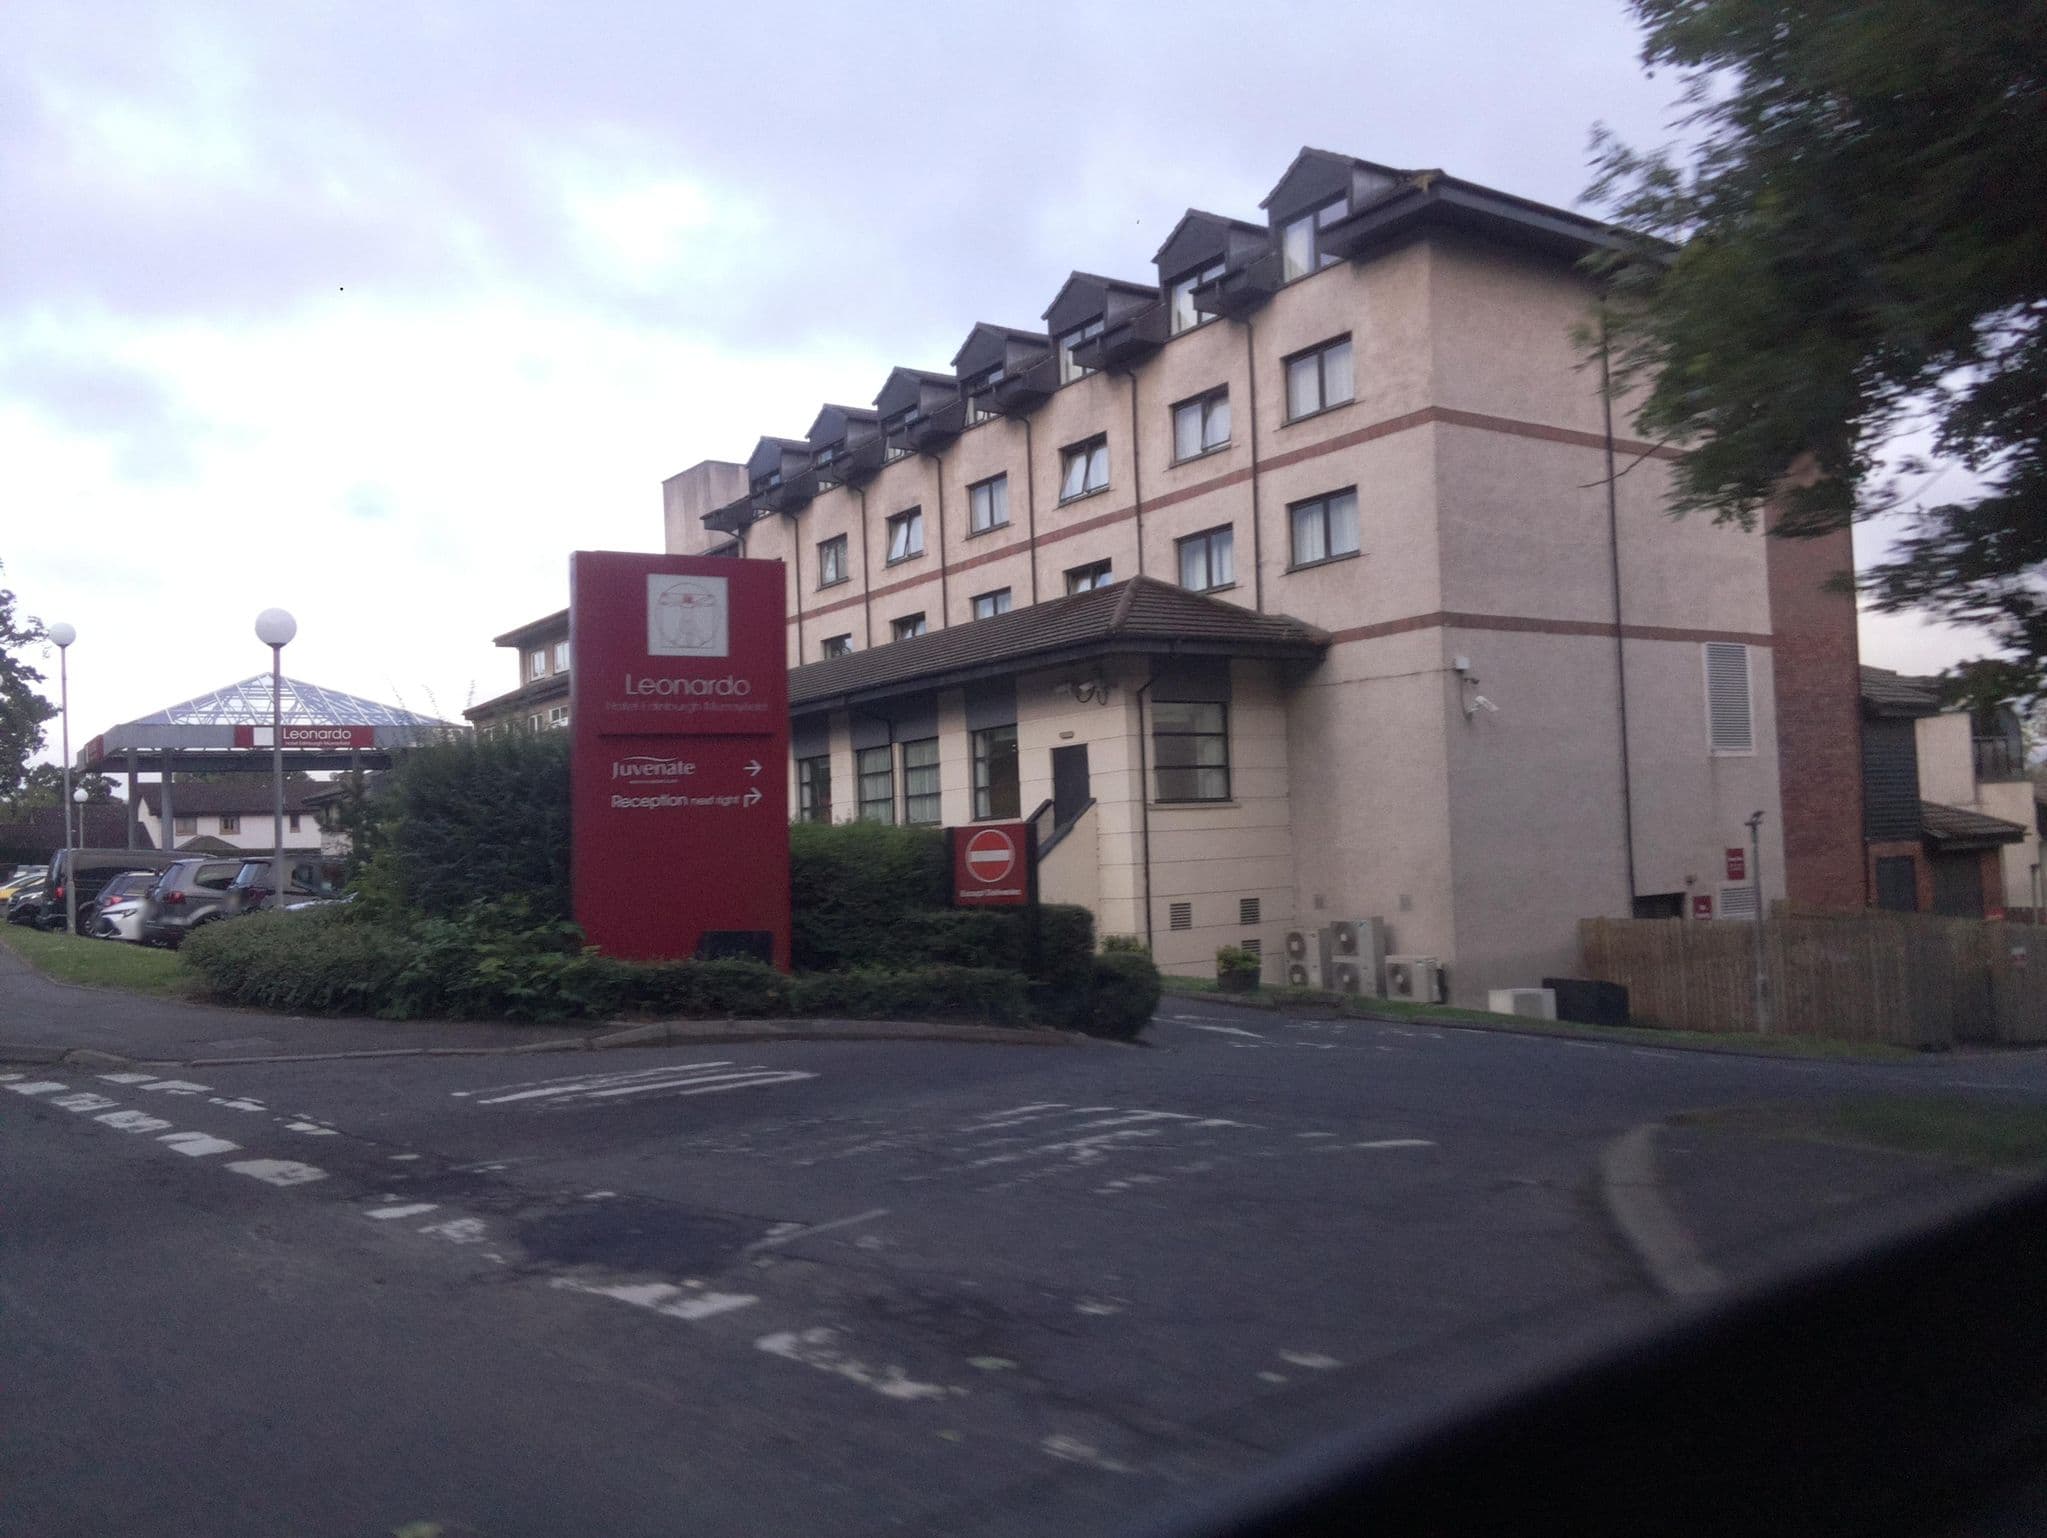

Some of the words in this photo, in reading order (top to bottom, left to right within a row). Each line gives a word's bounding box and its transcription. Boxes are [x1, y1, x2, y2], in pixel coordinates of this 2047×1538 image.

[626, 674, 750, 695] Leonardo
[283, 728, 351, 740] Leonardo
[612, 761, 696, 778] Juvenate
[611, 795, 688, 808] Reception
